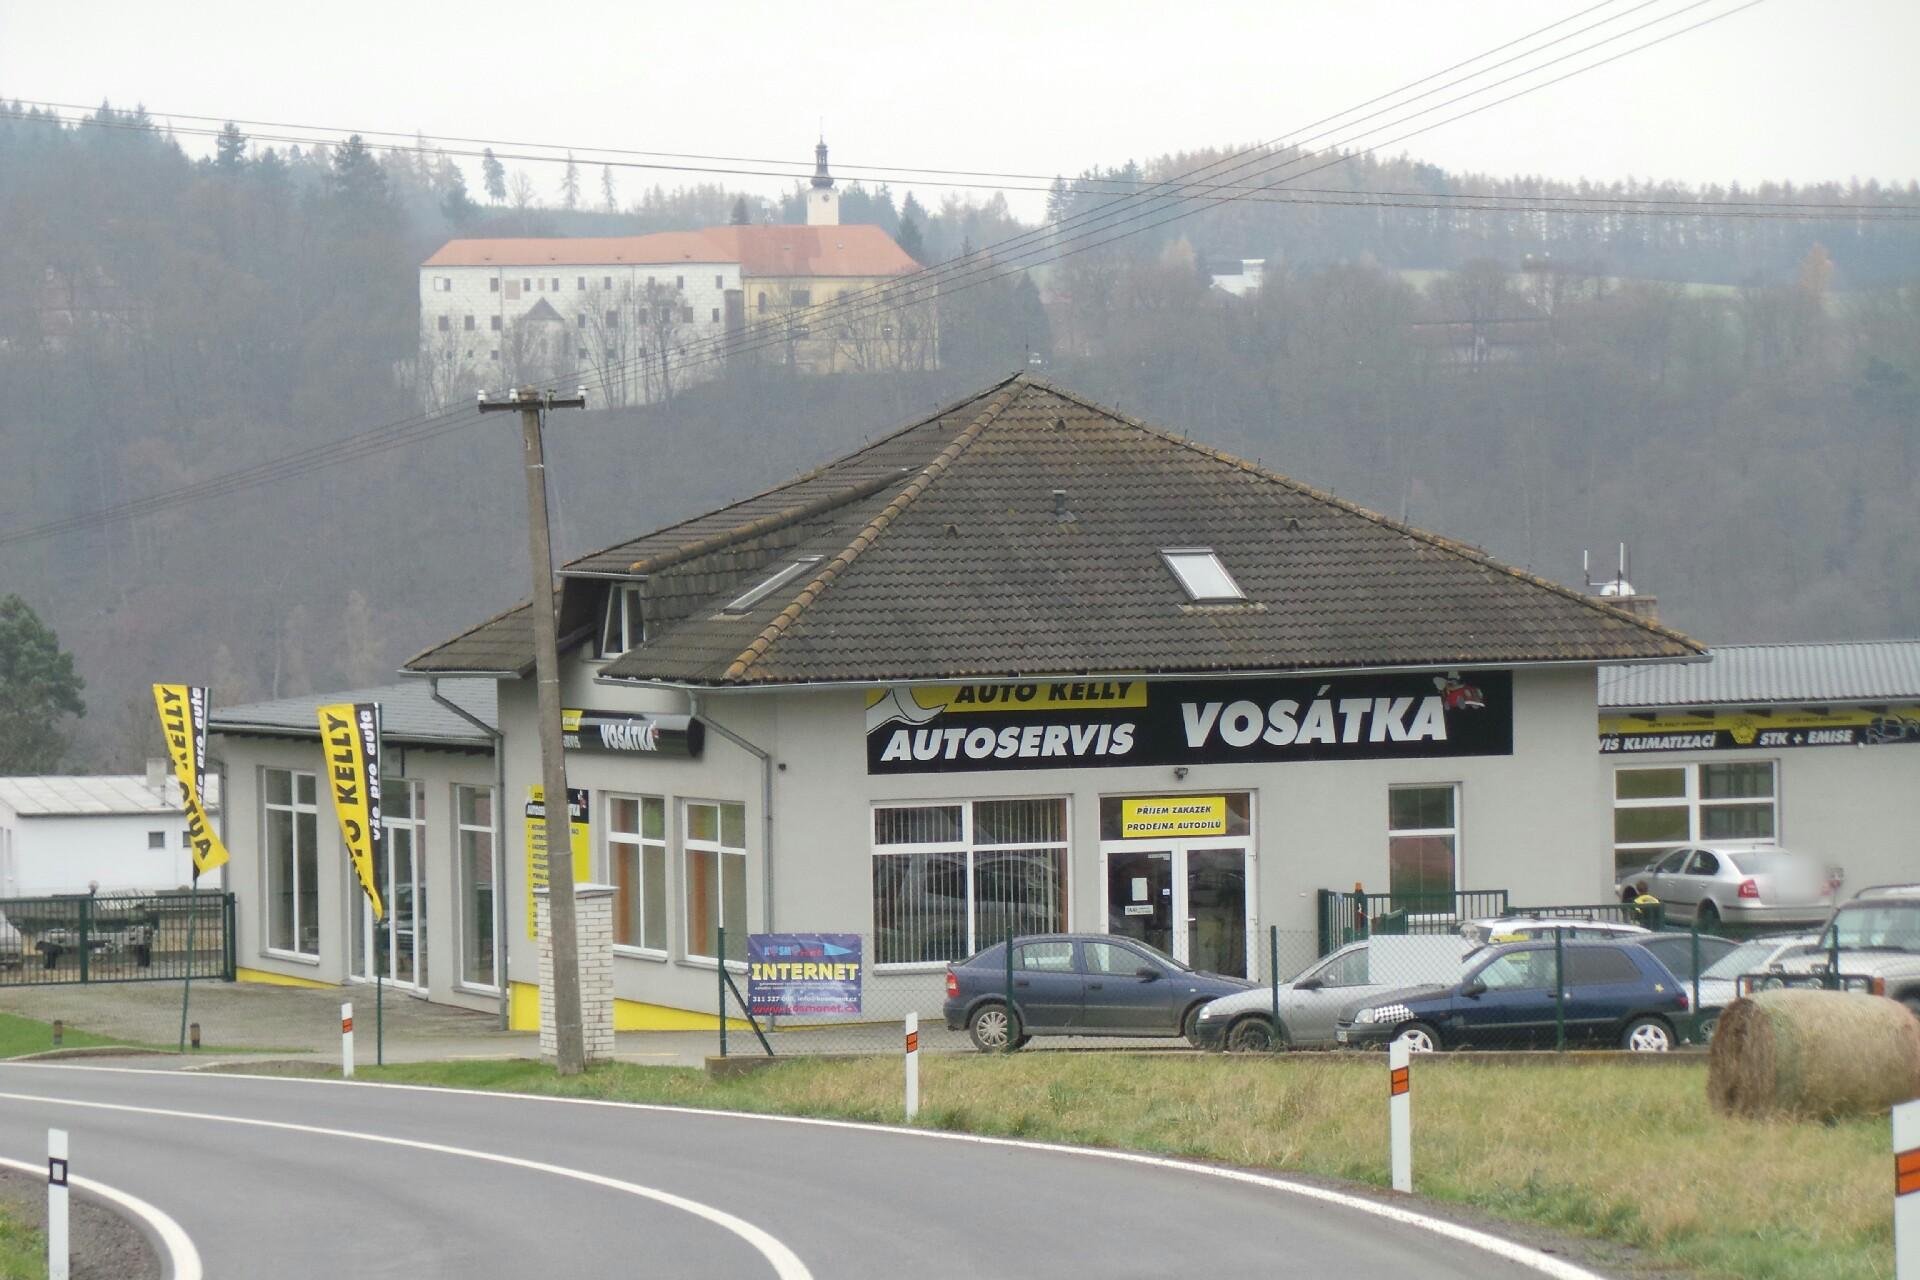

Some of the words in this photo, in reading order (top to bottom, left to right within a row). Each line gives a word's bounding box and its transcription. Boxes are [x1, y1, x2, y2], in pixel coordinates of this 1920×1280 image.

[954, 684, 1038, 703] AUTO
[1047, 682, 1133, 701] KELLY
[360, 709, 377, 756] auto
[1181, 684, 1448, 748] VOSÁTKA
[600, 717, 658, 752] VOSÁTKA
[880, 722, 1136, 762] AUTOSERVIS
[1623, 731, 1717, 750] KLIMATIZACÍ
[1760, 732, 1790, 746] STK
[1808, 729, 1854, 744] EMISE
[326, 712, 359, 806] KELLY
[368, 762, 381, 800] pro
[1127, 822, 1174, 831] PRODEJNA
[751, 962, 860, 981] INTERNET
